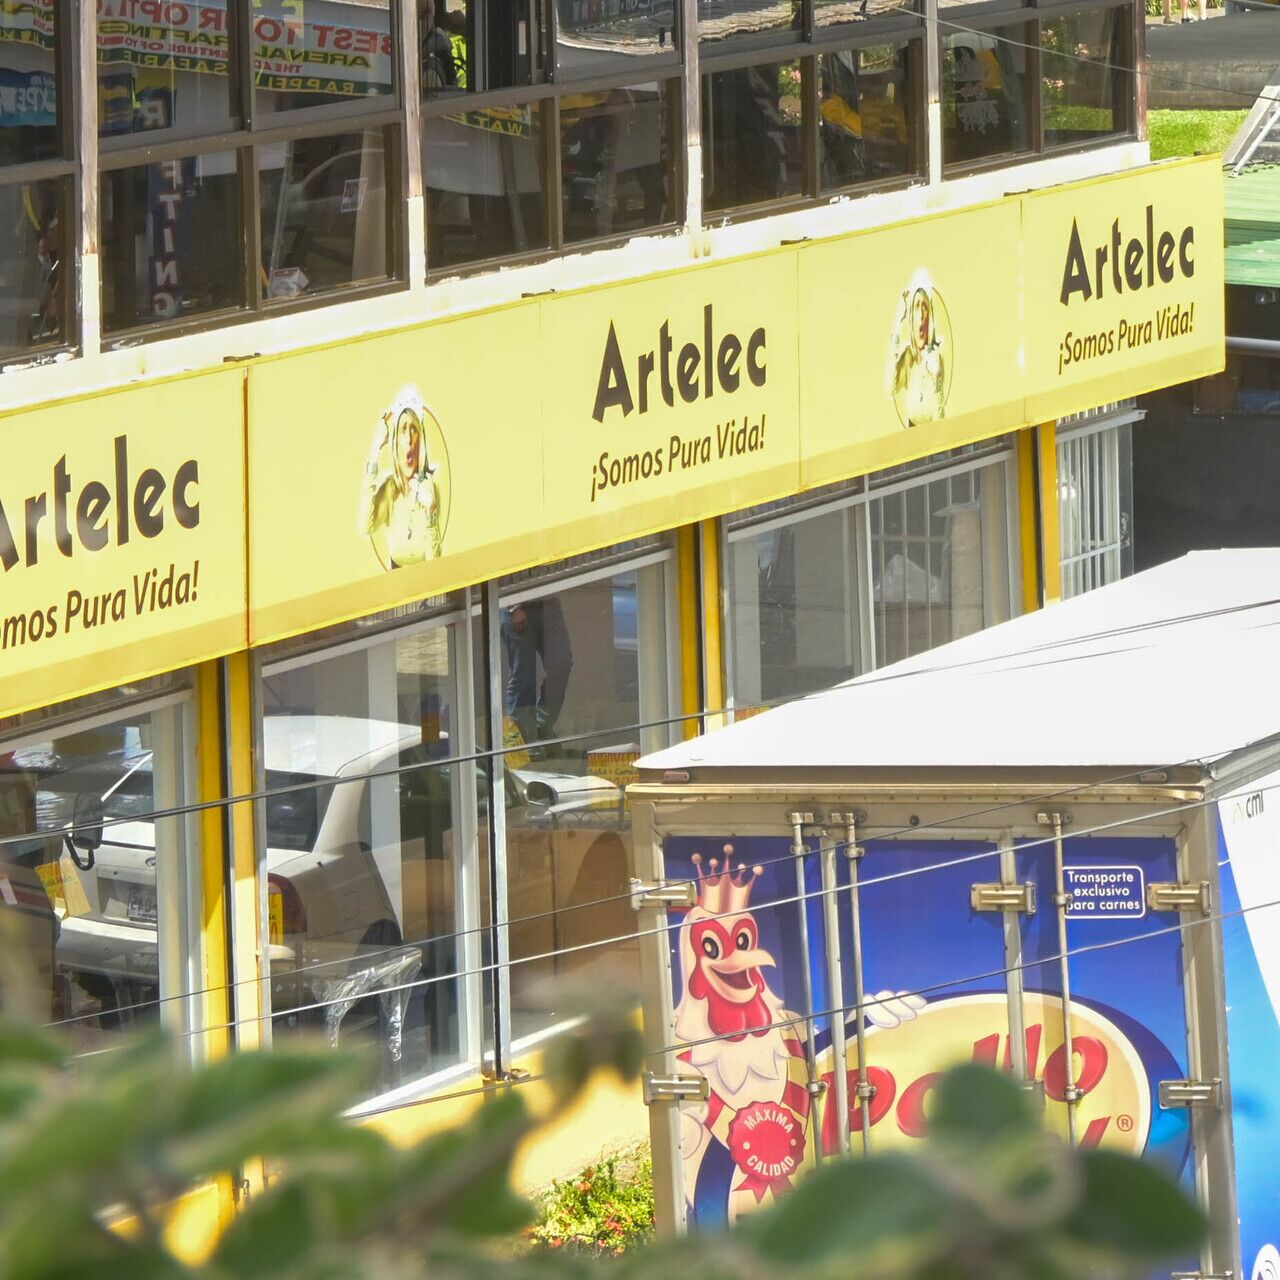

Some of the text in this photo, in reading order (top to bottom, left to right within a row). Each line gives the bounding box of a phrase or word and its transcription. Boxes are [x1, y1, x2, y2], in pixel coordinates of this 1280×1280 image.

[1060, 205, 1195, 306] Artelec
[592, 304, 767, 423] Artelec
[1059, 302, 1194, 375] ¡Somos Pura Vida!
[591, 414, 766, 502] ¡Somos Pura Vida!
[64, 589, 126, 633] Pura
[132, 560, 200, 616] Vida!
[1067, 871, 1134, 886] Transporte
[1067, 901, 1140, 914] para carnes
[1073, 883, 1130, 897] exclusivo
[746, 1154, 795, 1177] CALIDAD
